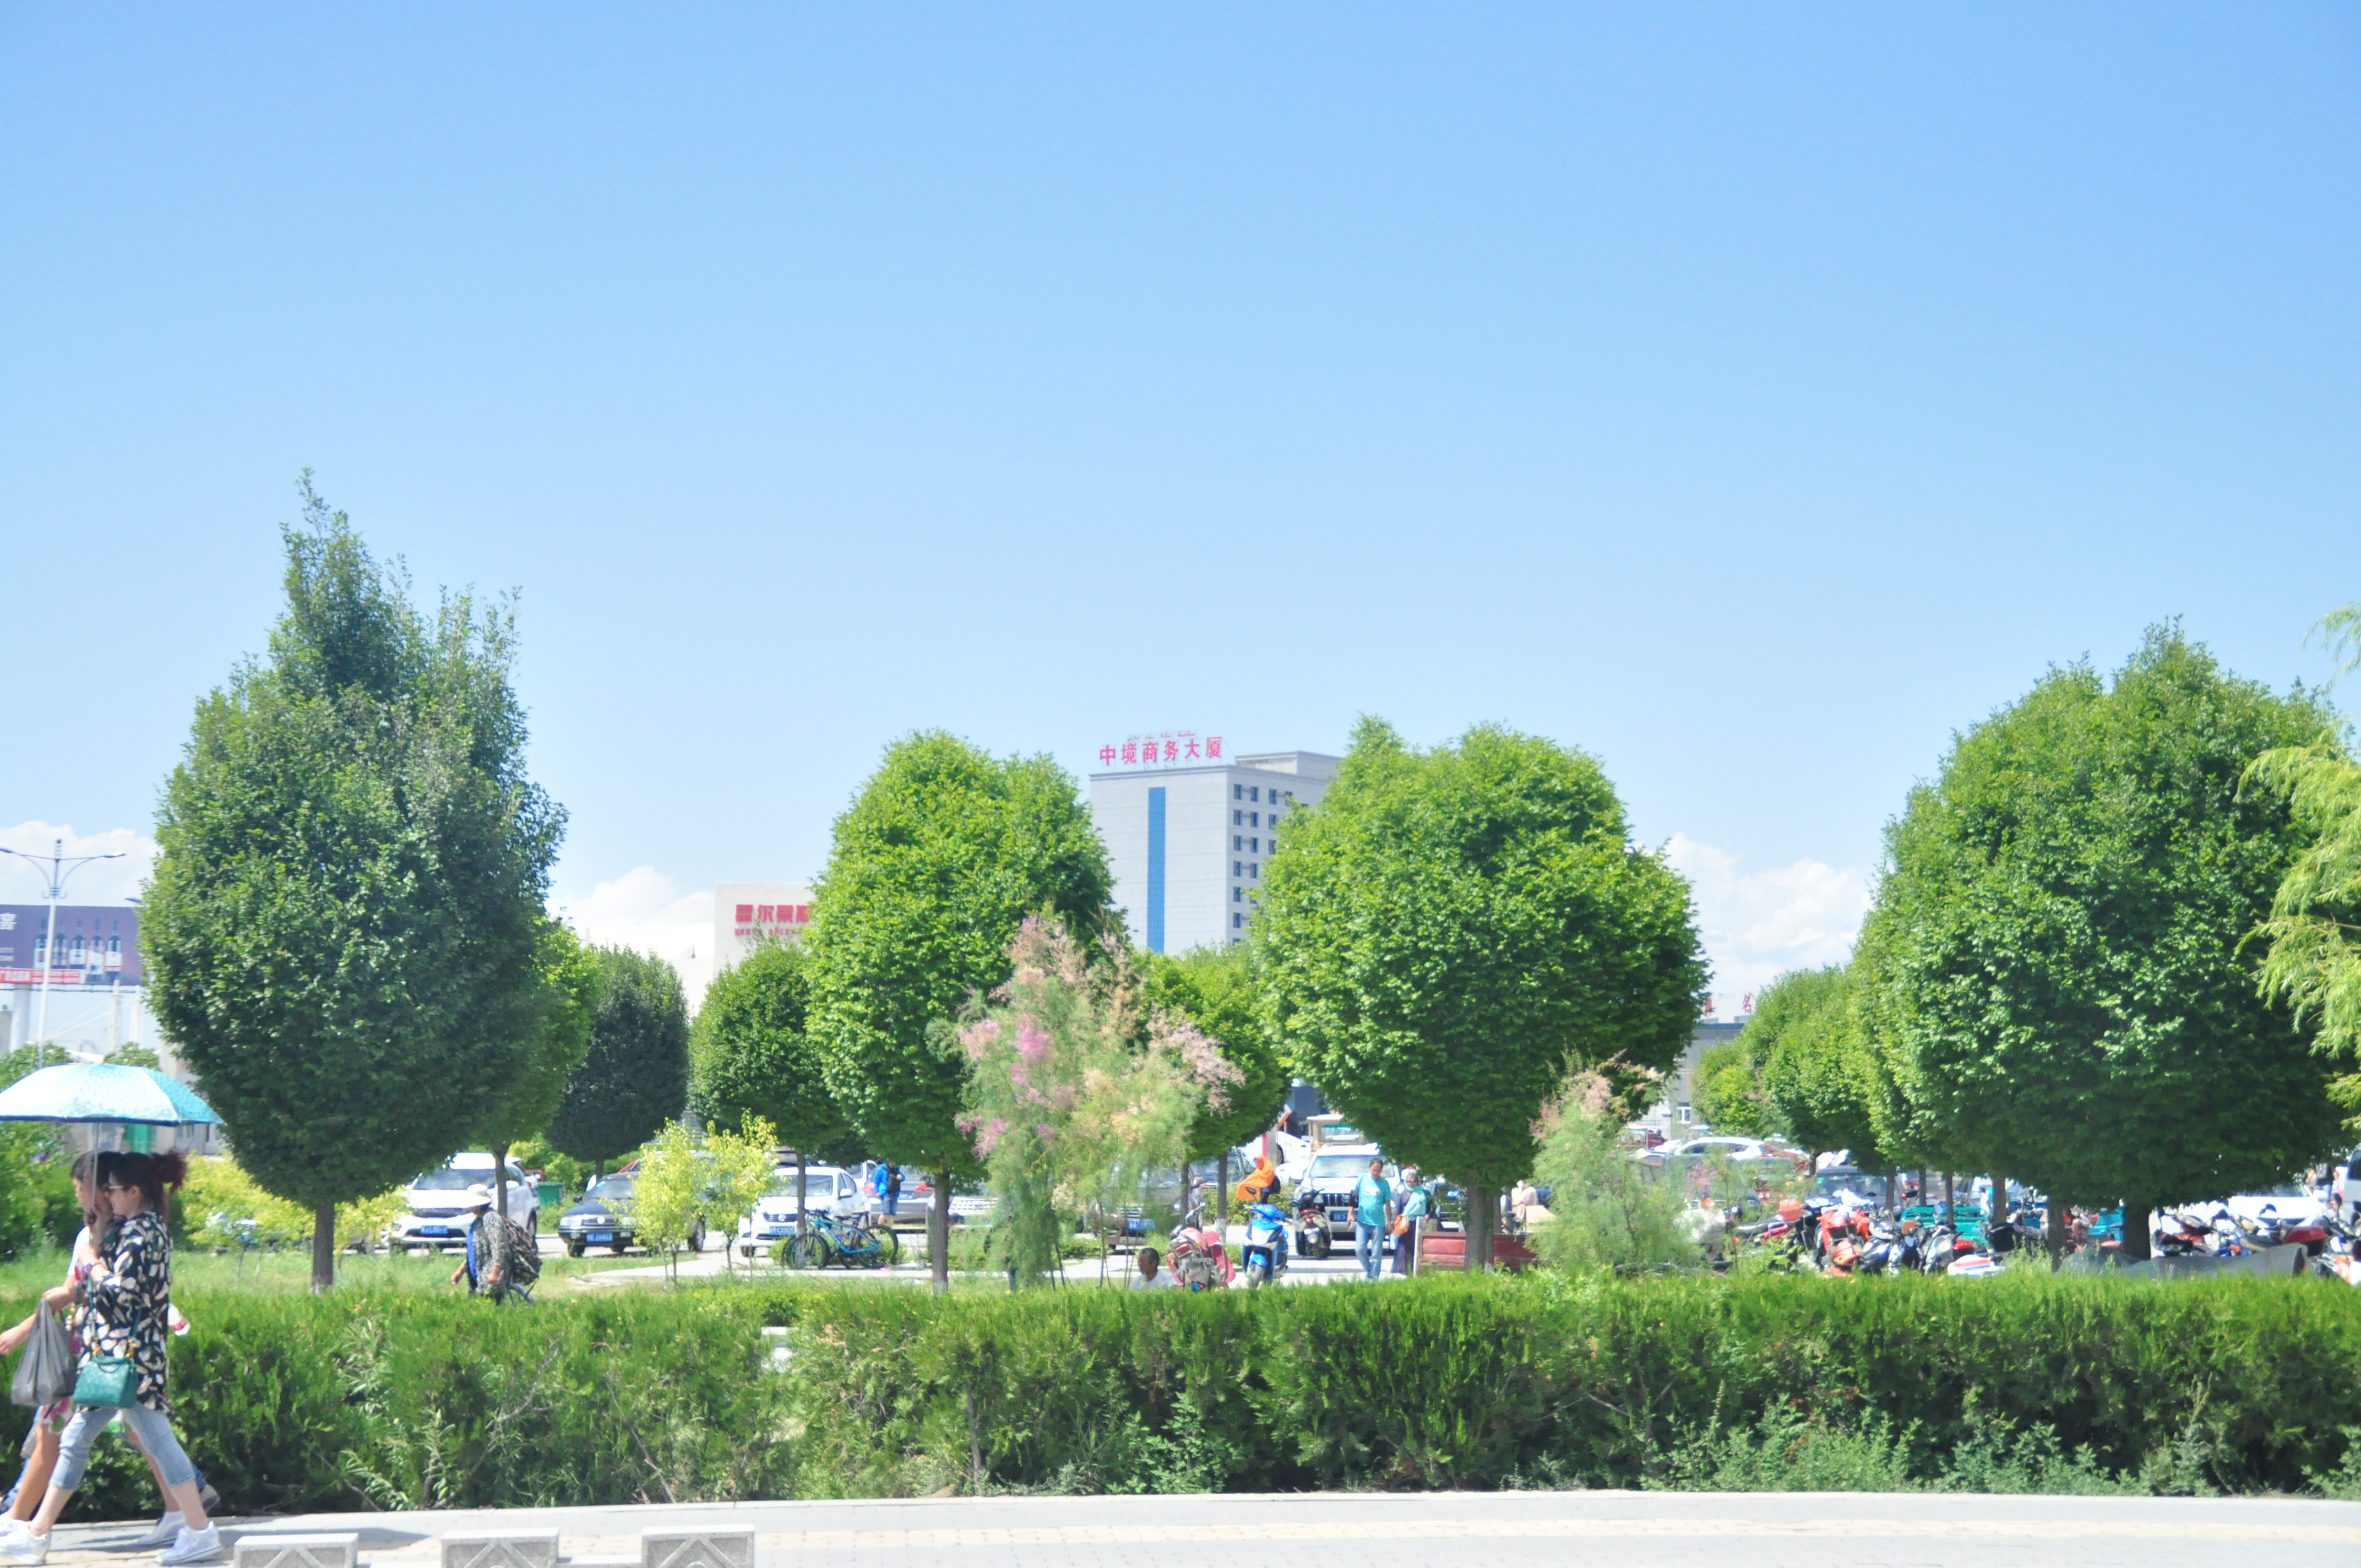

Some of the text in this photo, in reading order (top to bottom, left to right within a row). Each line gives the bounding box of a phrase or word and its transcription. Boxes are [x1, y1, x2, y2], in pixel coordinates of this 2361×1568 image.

[1099, 737, 1222, 766] 中境商务大厦
